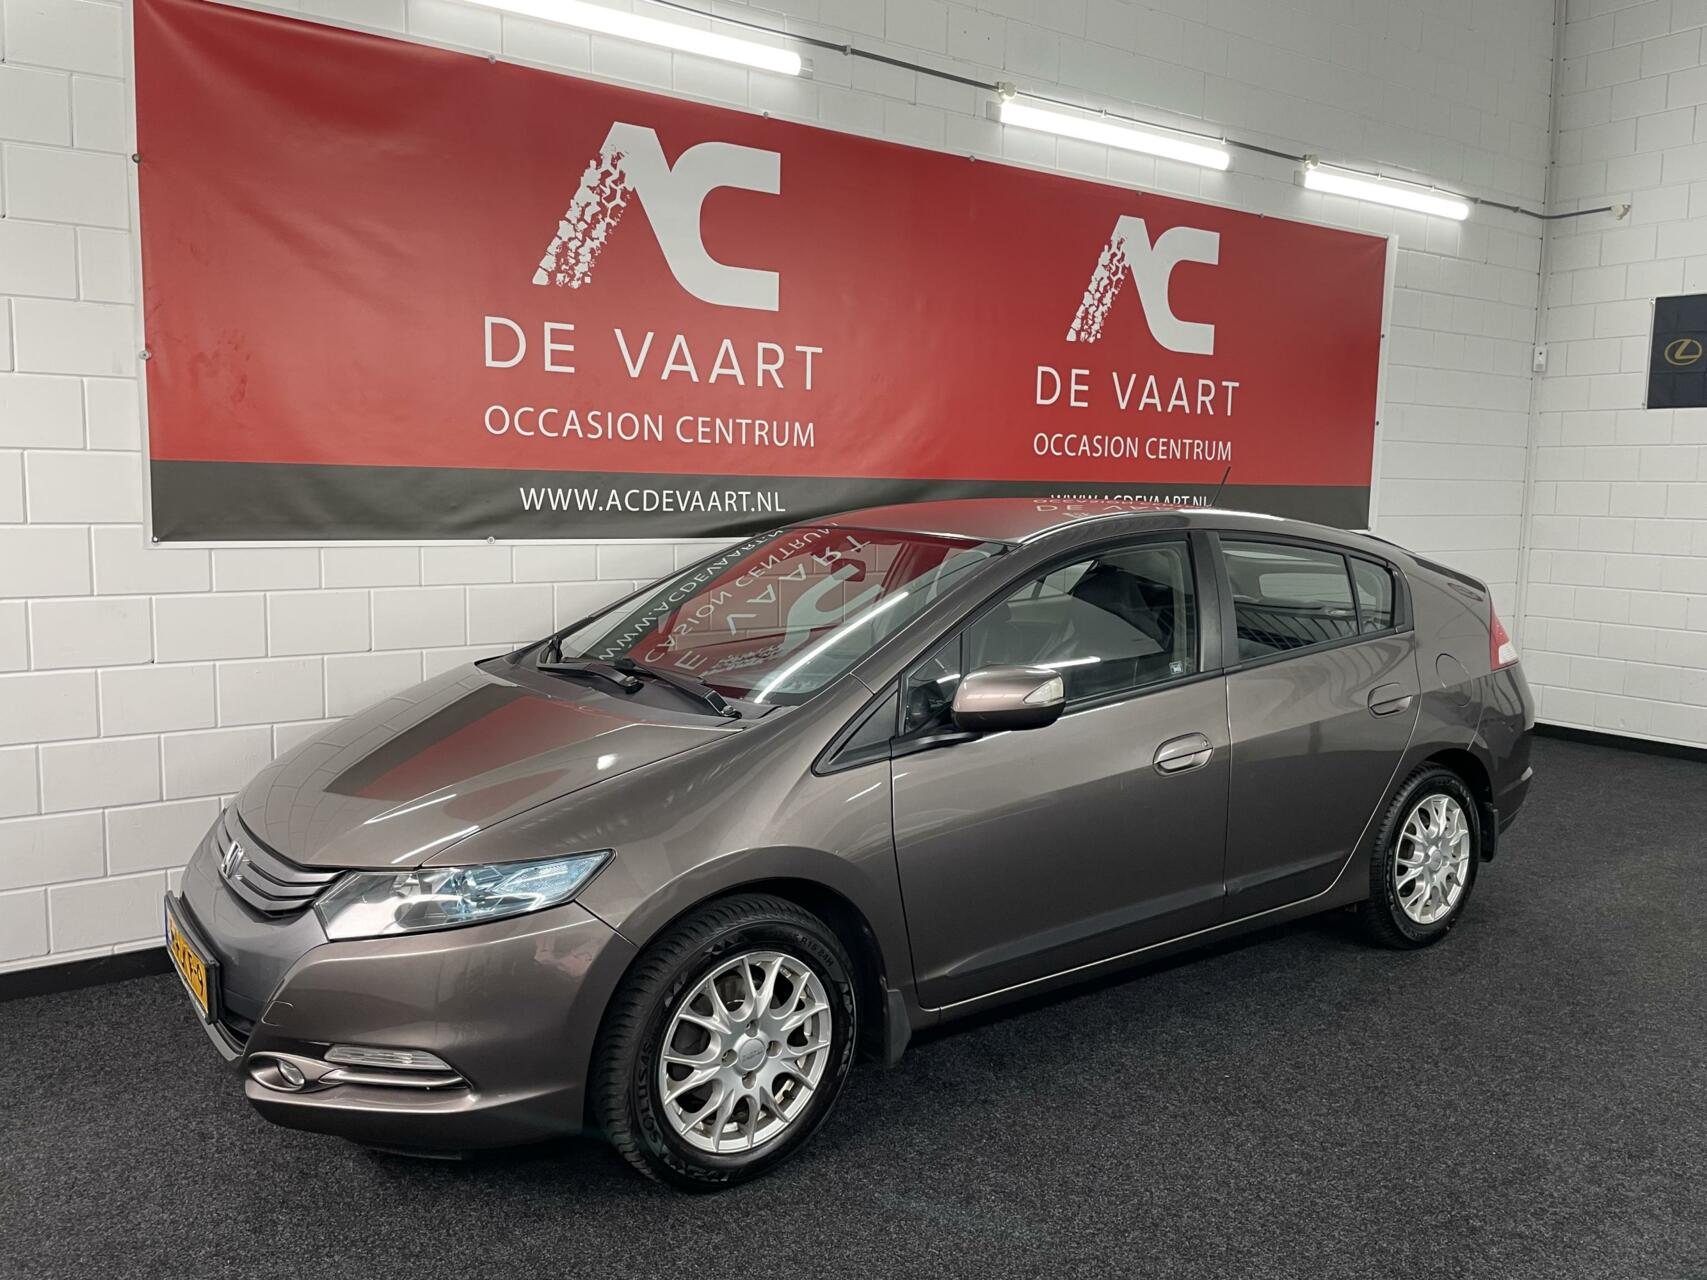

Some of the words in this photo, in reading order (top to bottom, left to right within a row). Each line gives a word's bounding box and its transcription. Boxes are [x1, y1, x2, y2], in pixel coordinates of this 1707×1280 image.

[532, 121, 782, 312] AC
[1066, 214, 1220, 356] AC
[484, 316, 576, 374] DE
[614, 328, 823, 390] VAART
[1036, 366, 1090, 408] DE
[1112, 372, 1240, 417] VAART
[484, 405, 663, 442] OCCASION
[676, 416, 815, 448] CENTRUM
[1033, 432, 1139, 458] OCCASION
[1145, 437, 1232, 461] CENTRUM
[519, 487, 786, 512] WWW.ACDEVAART.NL
